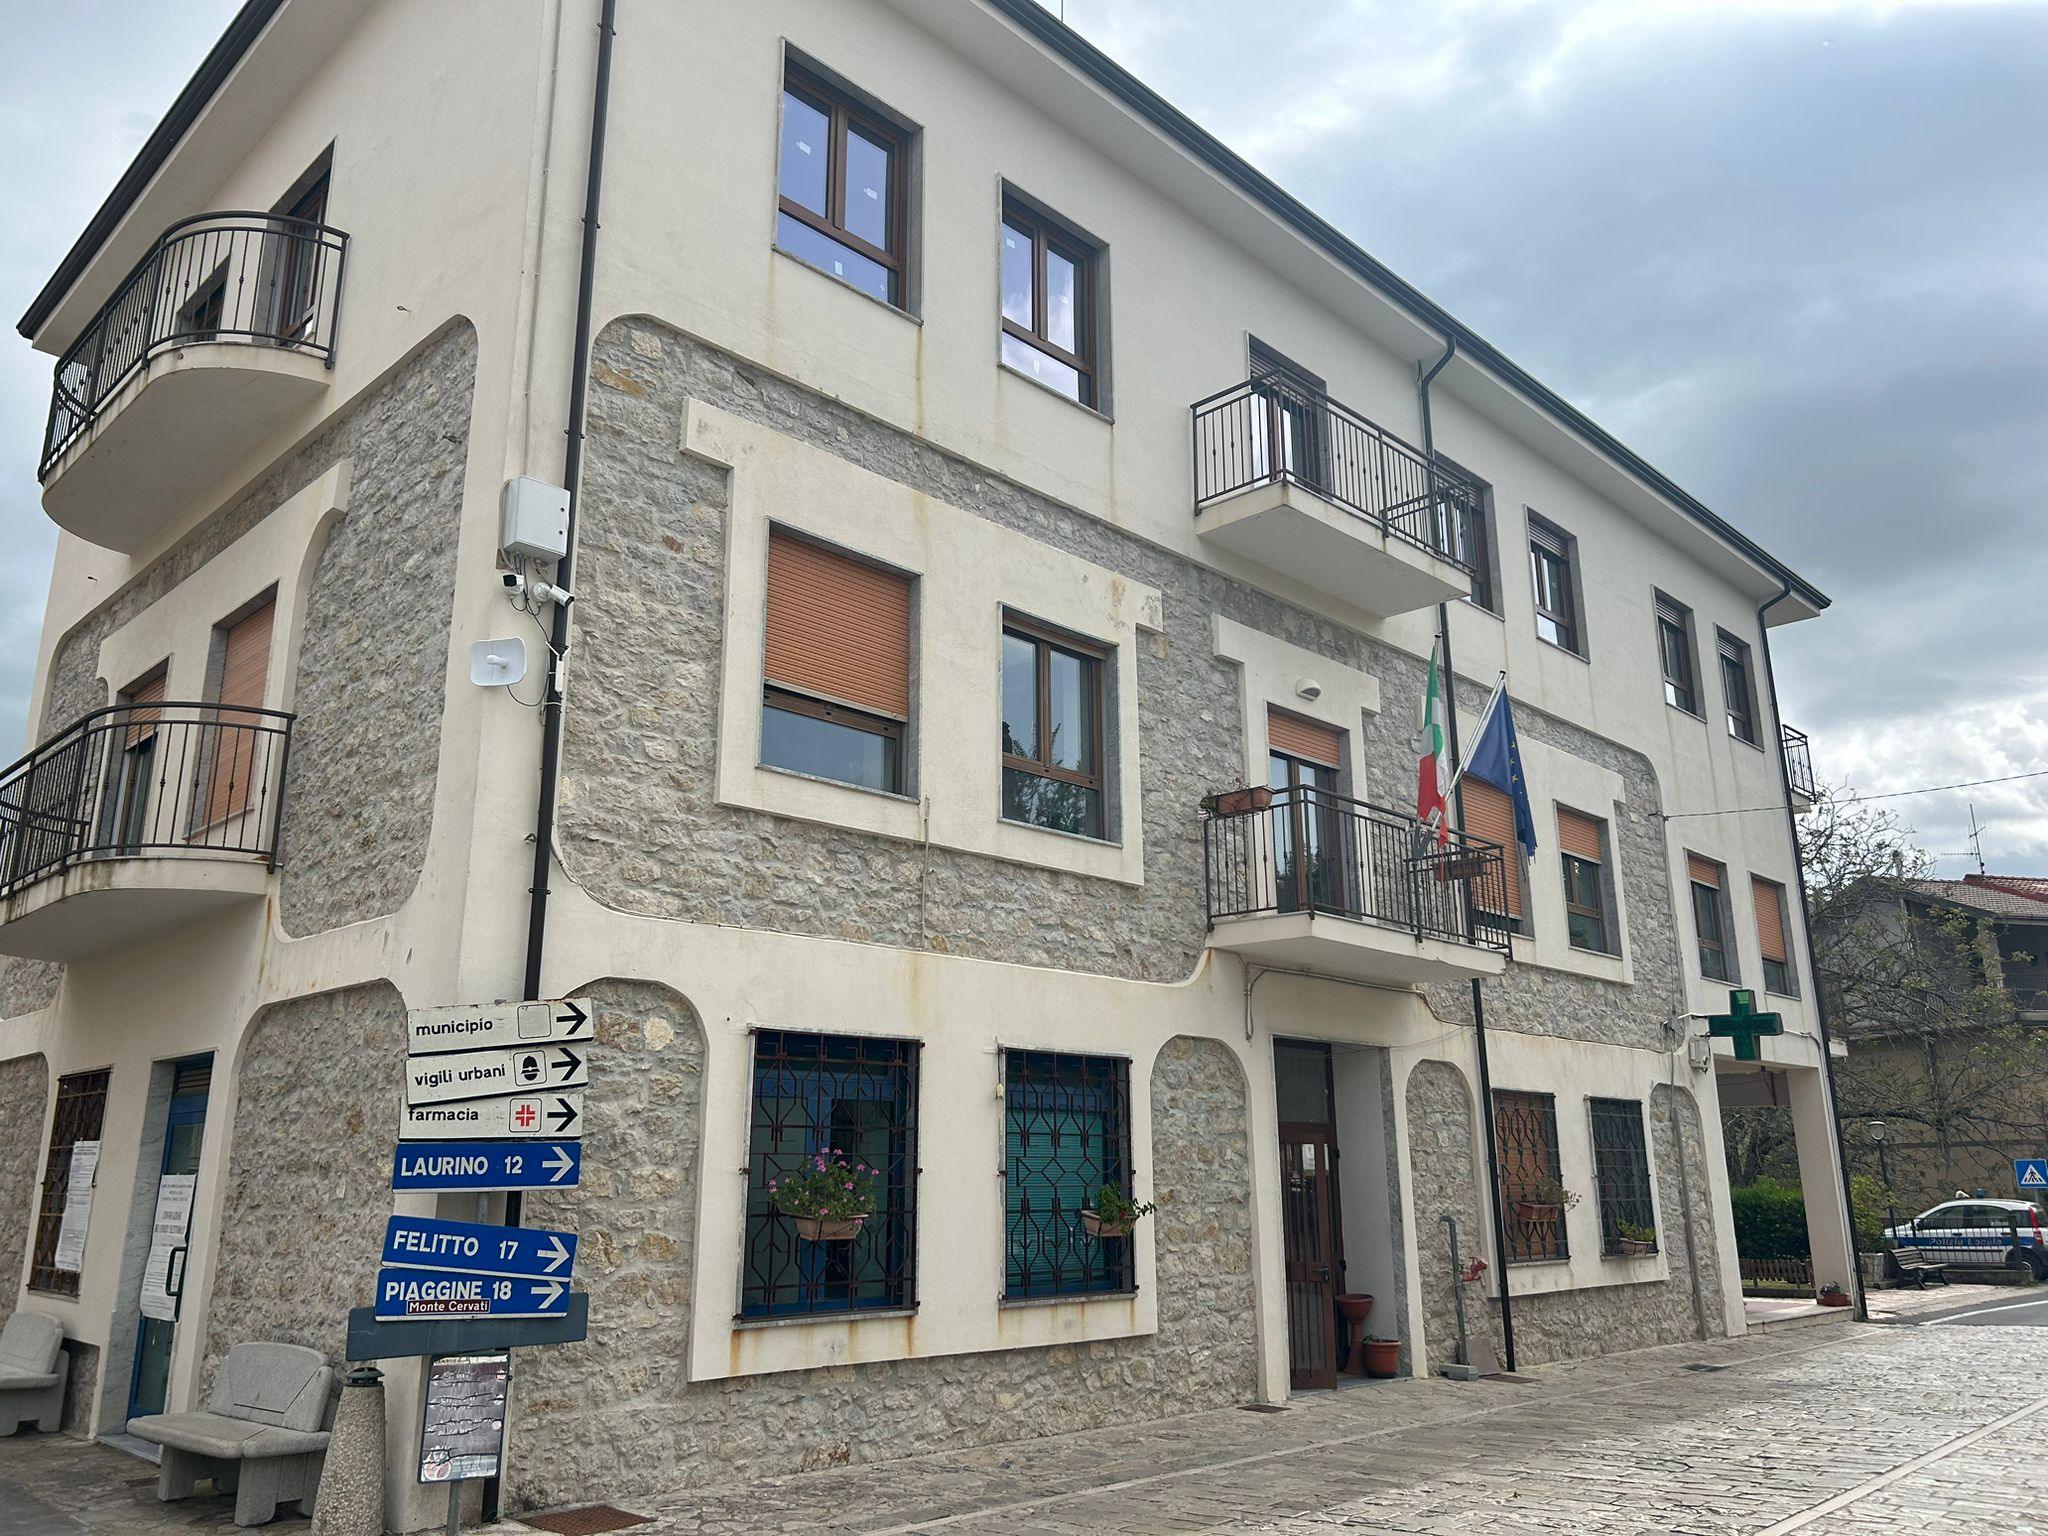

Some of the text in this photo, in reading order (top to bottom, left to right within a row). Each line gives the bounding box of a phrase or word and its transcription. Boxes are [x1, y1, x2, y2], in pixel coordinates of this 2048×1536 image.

[416, 1018, 492, 1035] municipio
[415, 1065, 505, 1087] vigili urbani
[408, 1107, 478, 1121] farmacia
[400, 1155, 522, 1176] LAURINO 12
[393, 1230, 518, 1259] FELITTO 17
[385, 1280, 511, 1301] PIAGGINE 18
[409, 1301, 488, 1312] Monte Cervati
